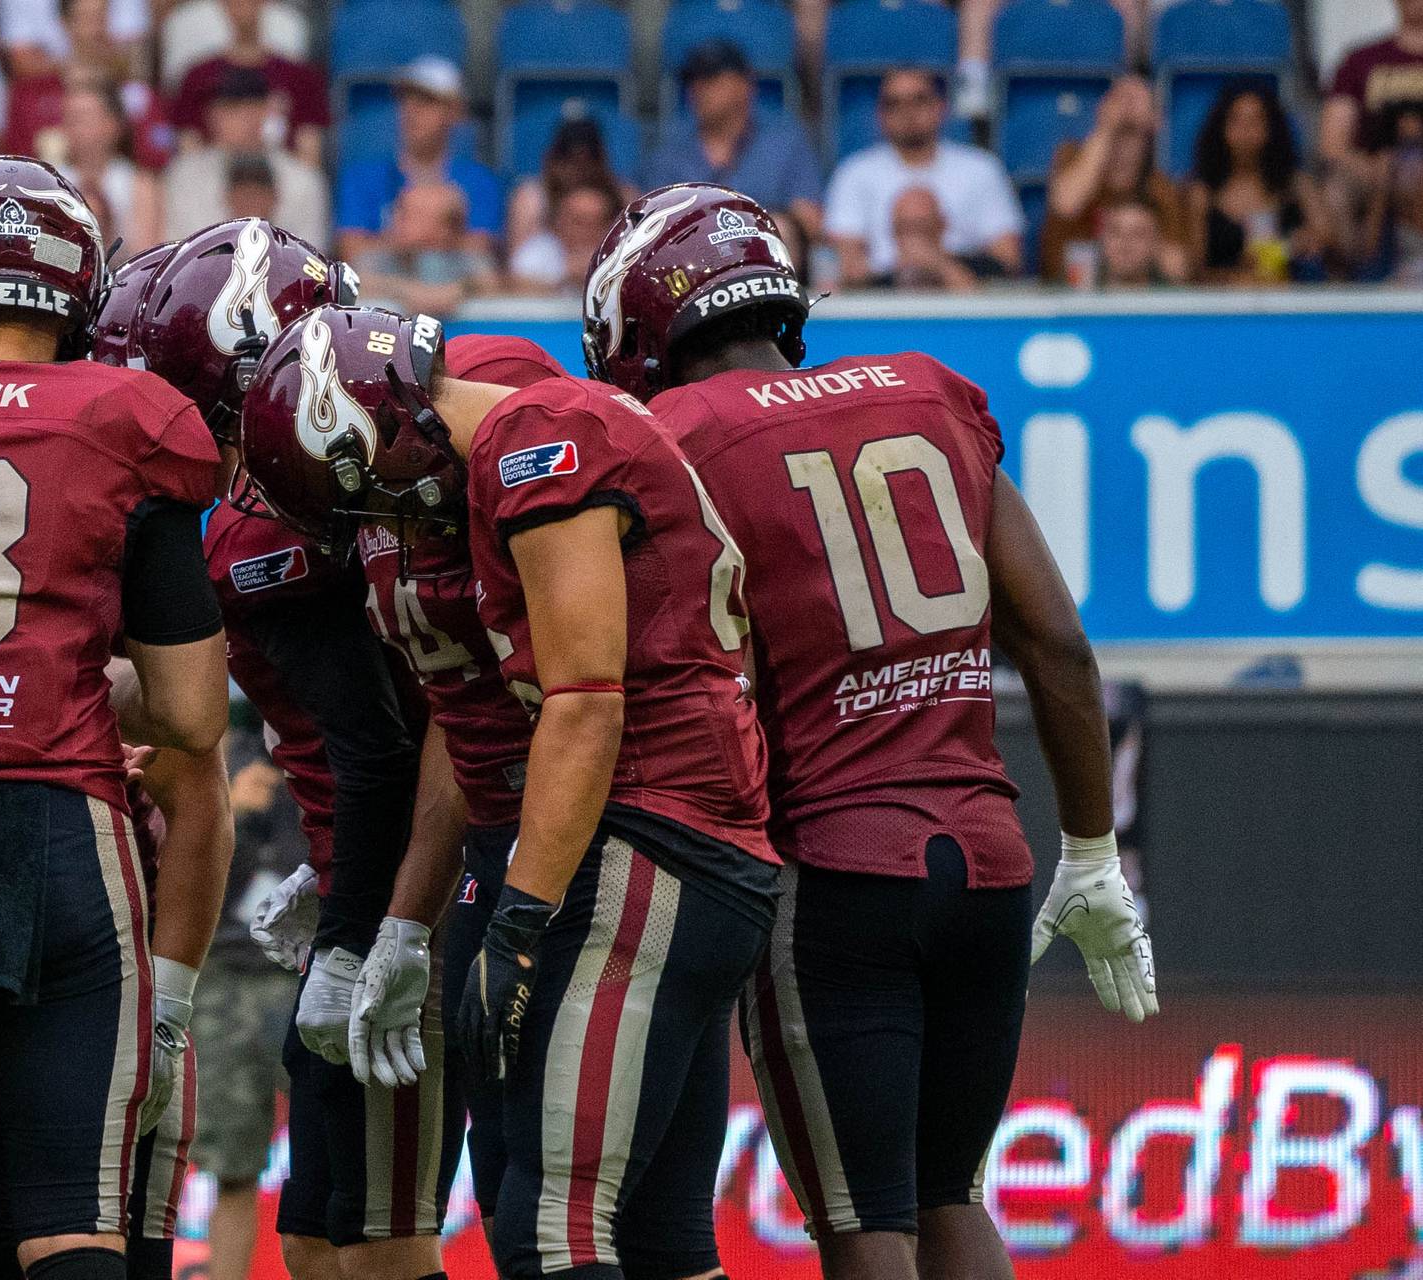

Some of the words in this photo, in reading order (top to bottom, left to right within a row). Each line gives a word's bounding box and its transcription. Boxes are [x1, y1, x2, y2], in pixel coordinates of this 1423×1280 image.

[710, 228, 759, 243] BURNHARD
[303, 256, 328, 283] 84
[664, 268, 691, 299] 10
[694, 277, 800, 317] FORELLE
[367, 331, 396, 355] 86
[746, 365, 905, 408] KWOFIE
[502, 452, 537, 468] EUROPEAN
[503, 463, 527, 475] LEAGUE
[504, 467, 537, 482] FOOTBALL
[784, 434, 990, 652] 10
[233, 561, 268, 575] EUROPEAN
[235, 571, 258, 582] LEAGUE
[237, 575, 269, 588] FOOTBALL
[835, 648, 991, 695] AMERICAN
[833, 671, 991, 716] TOURISTER
